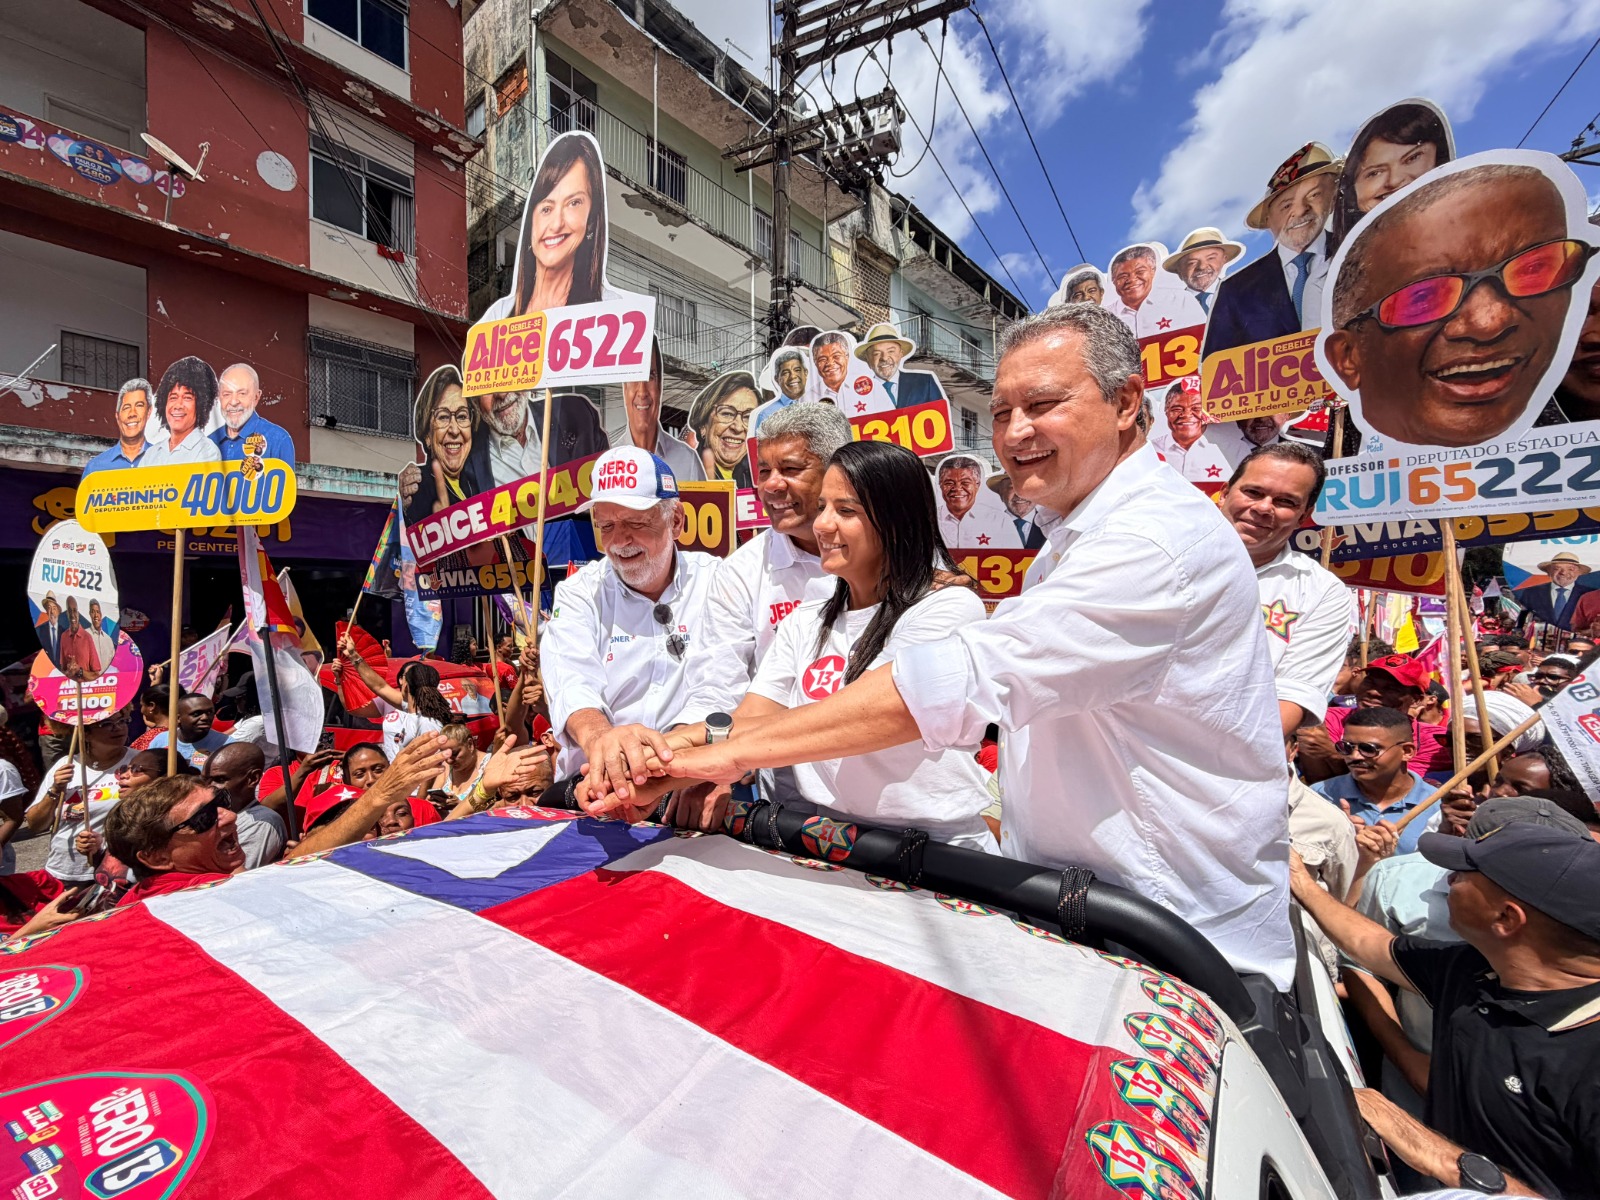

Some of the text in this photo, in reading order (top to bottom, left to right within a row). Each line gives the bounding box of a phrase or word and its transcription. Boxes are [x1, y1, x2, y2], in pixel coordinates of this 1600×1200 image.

[510, 317, 541, 332] REBELE-SE
[467, 323, 541, 371] Alice
[547, 310, 646, 372] 6522
[466, 363, 538, 384] PORTUGAL
[467, 376, 536, 392] Deputada Federal PCdoB
[1206, 382, 1332, 412] PORTUGAL
[1255, 401, 1290, 412] Federal
[1406, 444, 1500, 466] DEPUTADO
[598, 459, 638, 477] JERÔ
[1408, 445, 1600, 506] 65222
[181, 468, 286, 517] 40000
[598, 475, 638, 492] NIMO
[83, 487, 178, 514] MARINHO
[409, 501, 488, 559] LÍDICE
[157, 541, 176, 550] PE
[65, 567, 103, 591] 65222
[1269, 609, 1285, 627] 13
[816, 670, 835, 686] 13
[1571, 684, 1598, 701] 13
[818, 824, 837, 842] 13
[1158, 987, 1184, 1005] 13
[1143, 1023, 1173, 1044] 13
[1130, 1071, 1163, 1098] 13
[22, 1106, 51, 1131] LULA
[102, 1144, 165, 1191] 13
[1109, 1140, 1147, 1175] 13
